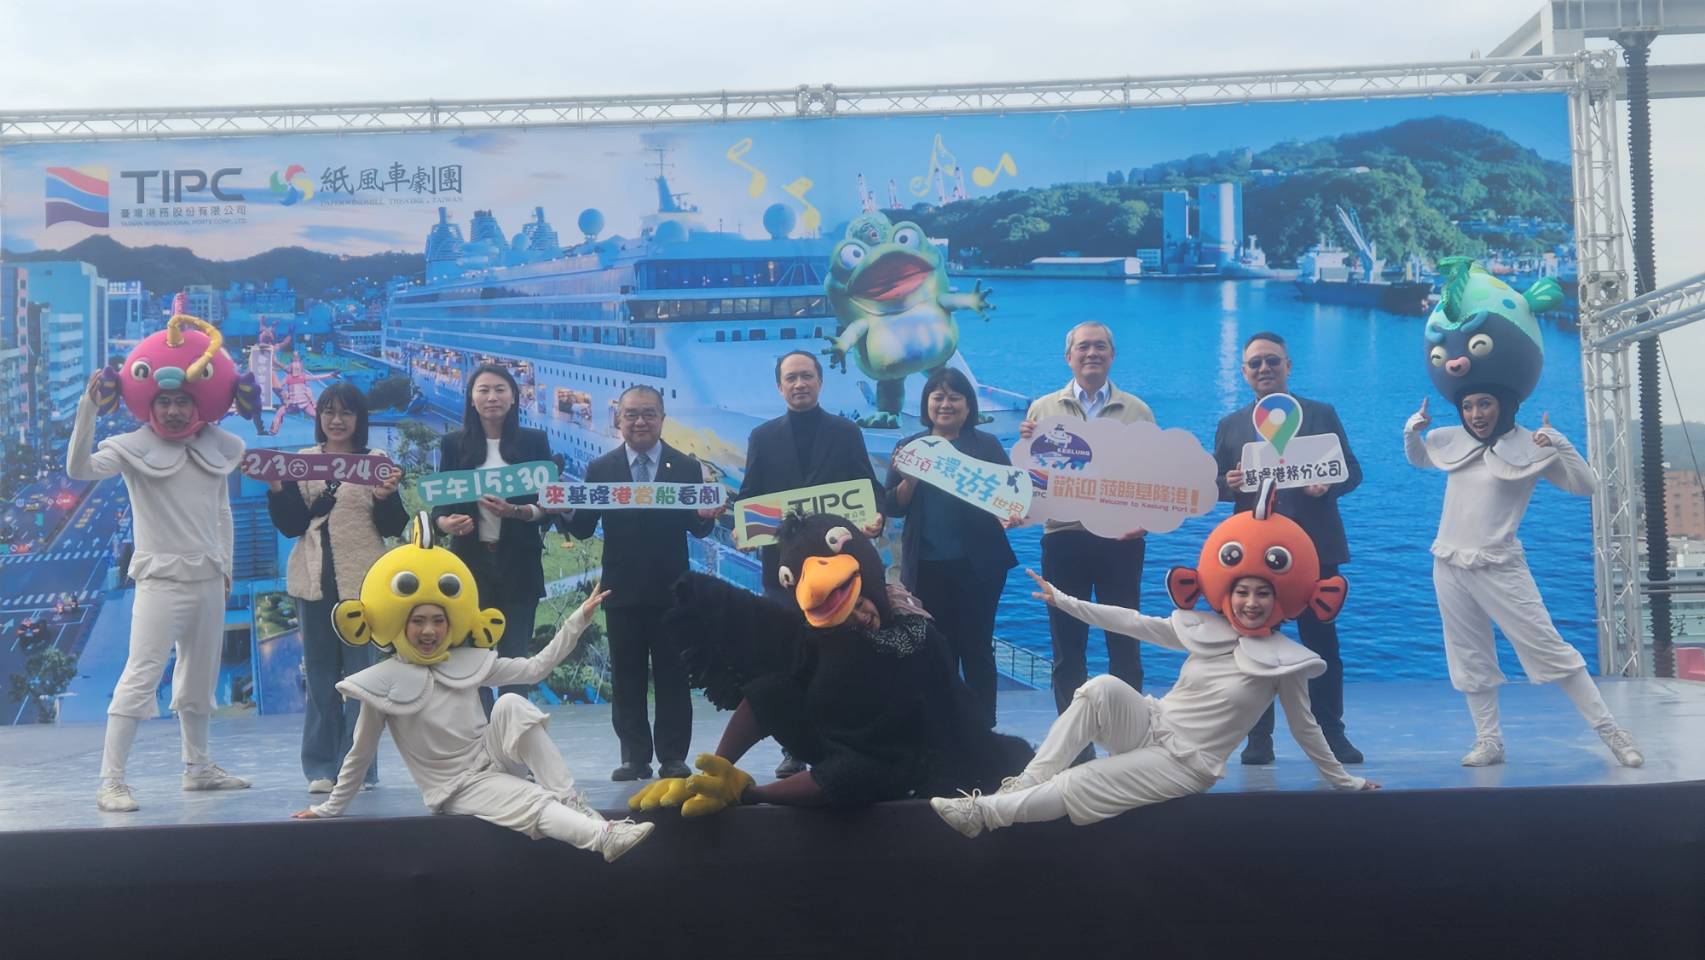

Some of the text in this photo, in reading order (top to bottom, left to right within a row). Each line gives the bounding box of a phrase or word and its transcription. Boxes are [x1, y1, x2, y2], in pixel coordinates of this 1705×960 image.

[120, 168, 246, 204] TIPC
[320, 161, 462, 195] 紙風車劇團
[1057, 447, 1090, 456] KEELUNG
[787, 489, 864, 514] TIPC
[1099, 497, 1128, 506] Welcome
[1141, 502, 1168, 511] Keelung
